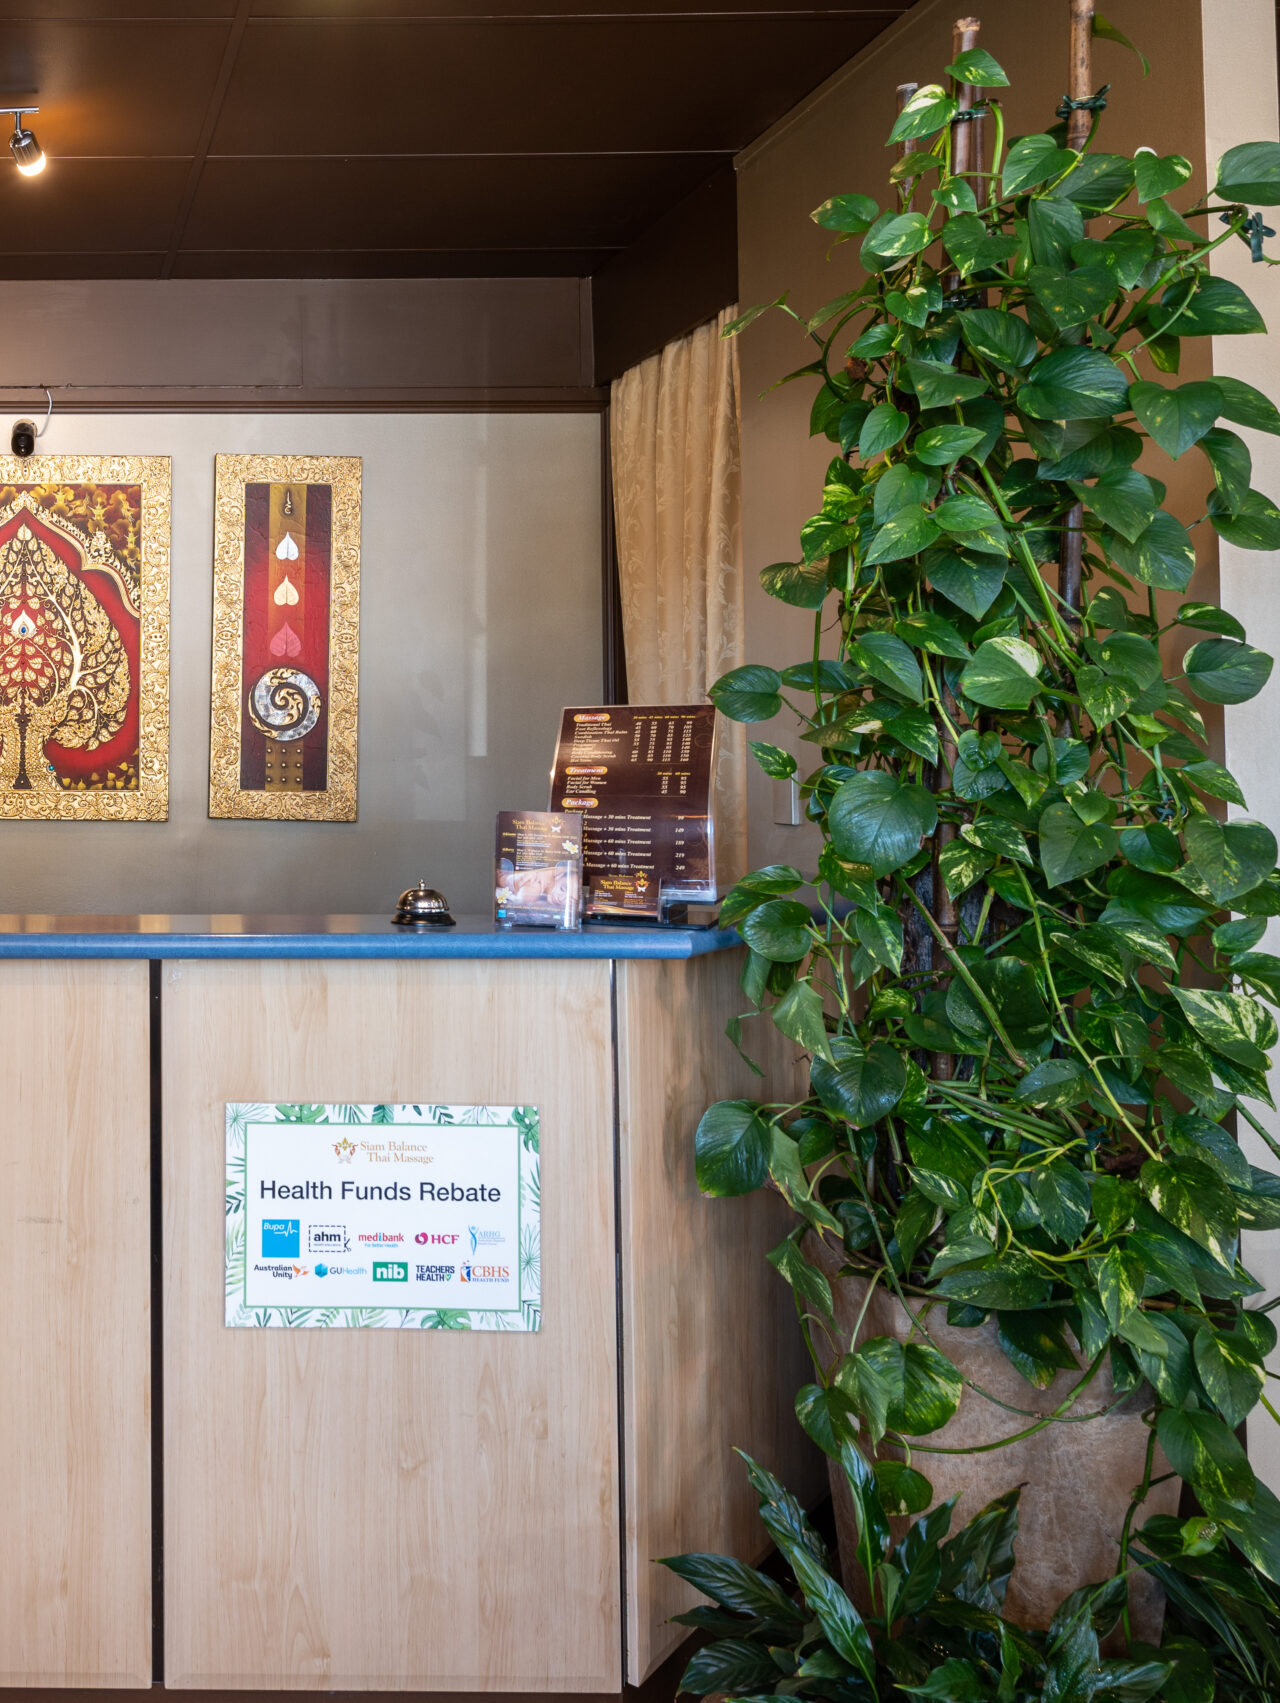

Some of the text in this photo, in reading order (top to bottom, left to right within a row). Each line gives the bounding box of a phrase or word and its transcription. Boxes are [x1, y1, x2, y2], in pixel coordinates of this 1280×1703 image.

[566, 799, 595, 807] Package
[360, 1140, 427, 1152] Siam Balance
[367, 1152, 434, 1165] Thai Massage
[260, 1180, 501, 1202] Health Funds Rebate
[263, 1222, 285, 1232] Bupa
[313, 1231, 341, 1242] ahm
[358, 1232, 404, 1242] medibank
[431, 1234, 460, 1245] HCF
[254, 1264, 293, 1272] Australian
[376, 1264, 405, 1279] nib
[416, 1265, 455, 1274] TEACHERS
[472, 1265, 510, 1278] CBHS
[272, 1271, 293, 1280] Unity
[416, 1273, 445, 1282] HEALTH
